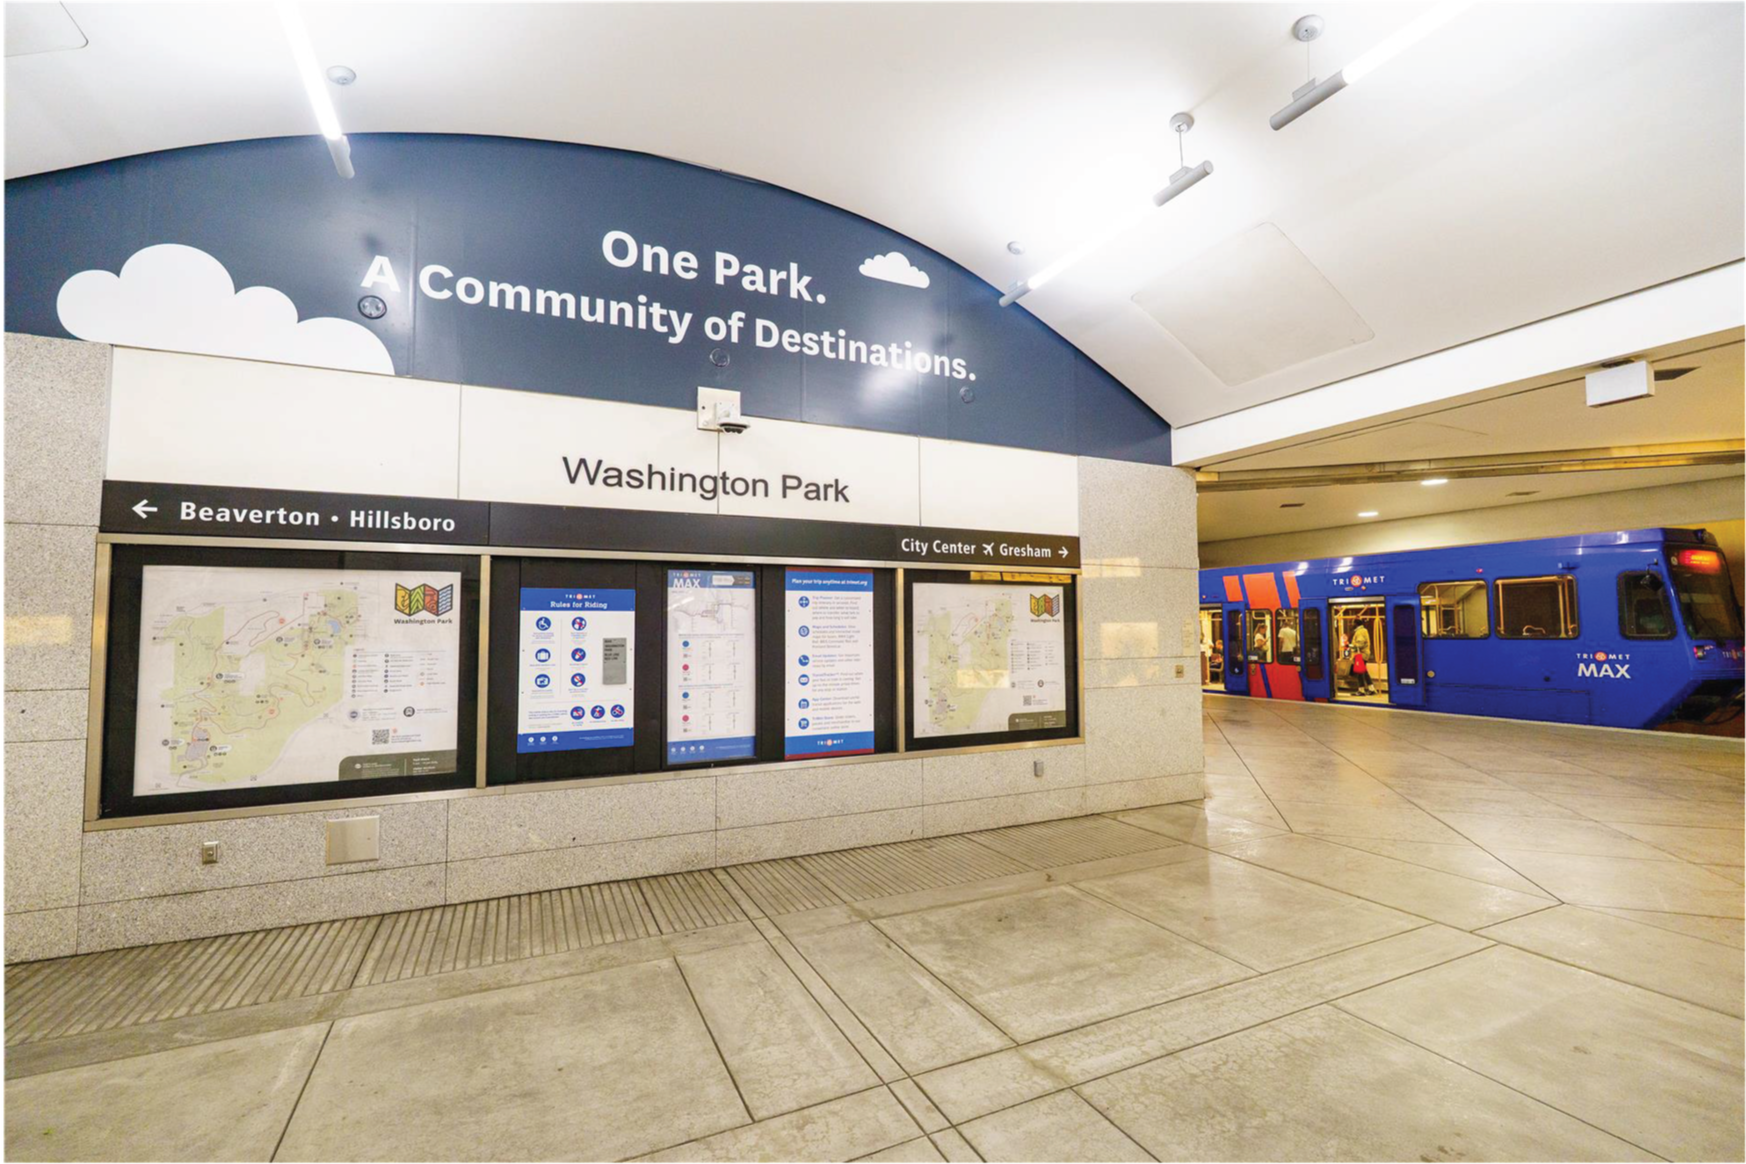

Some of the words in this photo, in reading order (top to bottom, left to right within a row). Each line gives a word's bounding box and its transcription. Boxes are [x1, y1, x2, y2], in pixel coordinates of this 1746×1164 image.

[602, 230, 699, 280] One
[715, 251, 826, 304] Park.
[360, 255, 401, 293] A
[419, 264, 693, 344] Community
[704, 311, 745, 343] of
[755, 318, 976, 381] Destinations.
[562, 456, 769, 501] Washington
[781, 474, 850, 503] Park
[180, 501, 320, 526] Beaverton
[350, 510, 455, 532] Hillsboro
[901, 538, 928, 555] City
[932, 540, 976, 555] Center
[999, 543, 1051, 558] Gresham
[672, 578, 701, 588] MAX
[1333, 578, 1349, 586] TRI
[1363, 576, 1385, 584] MET
[584, 601, 608, 610] Riding
[393, 618, 435, 626] Washington
[1577, 663, 1631, 679] MAX
